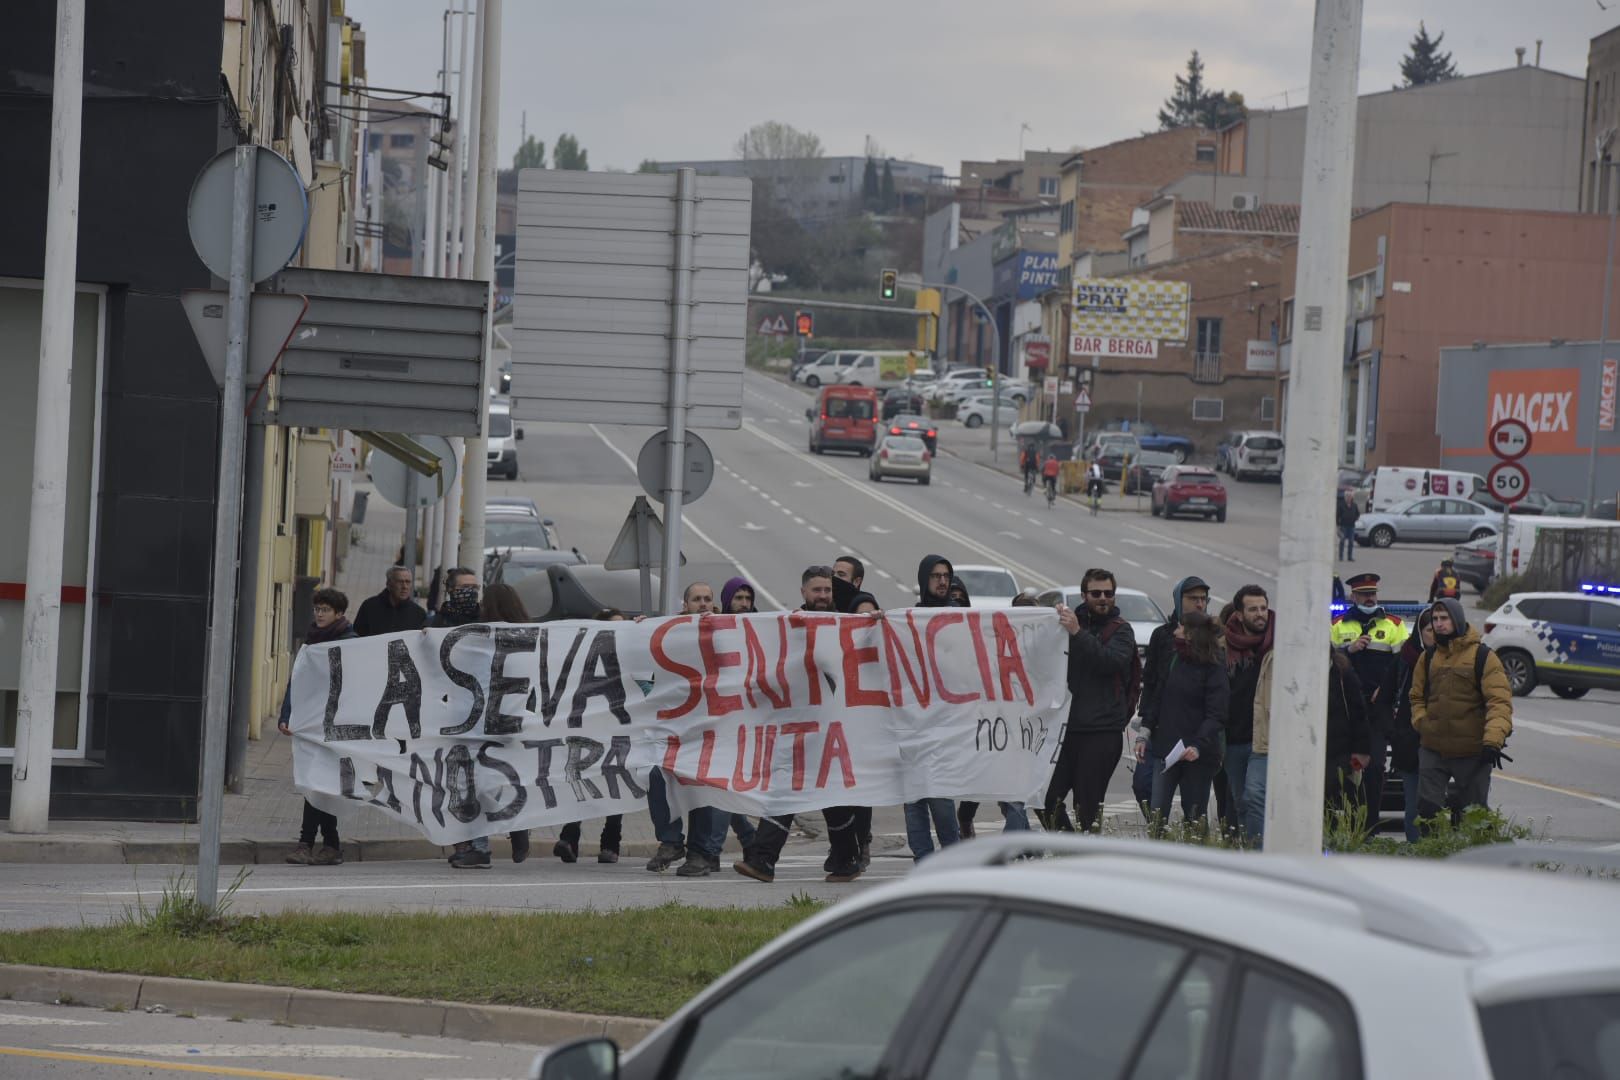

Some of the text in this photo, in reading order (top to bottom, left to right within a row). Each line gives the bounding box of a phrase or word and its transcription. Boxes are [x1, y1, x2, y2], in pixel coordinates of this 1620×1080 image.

[1077, 293, 1128, 306] PRAT
[1074, 336, 1102, 352] BAR
[1108, 339, 1154, 355] BERGA
[1491, 390, 1573, 433] NACEX
[1600, 364, 1617, 428] NACEX
[1496, 475, 1521, 490] 50
[323, 608, 1035, 743] LA SEVA SENTENCIA
[976, 716, 1008, 752] no
[409, 735, 647, 828] NOSTRA
[662, 720, 857, 792] LLUITA
